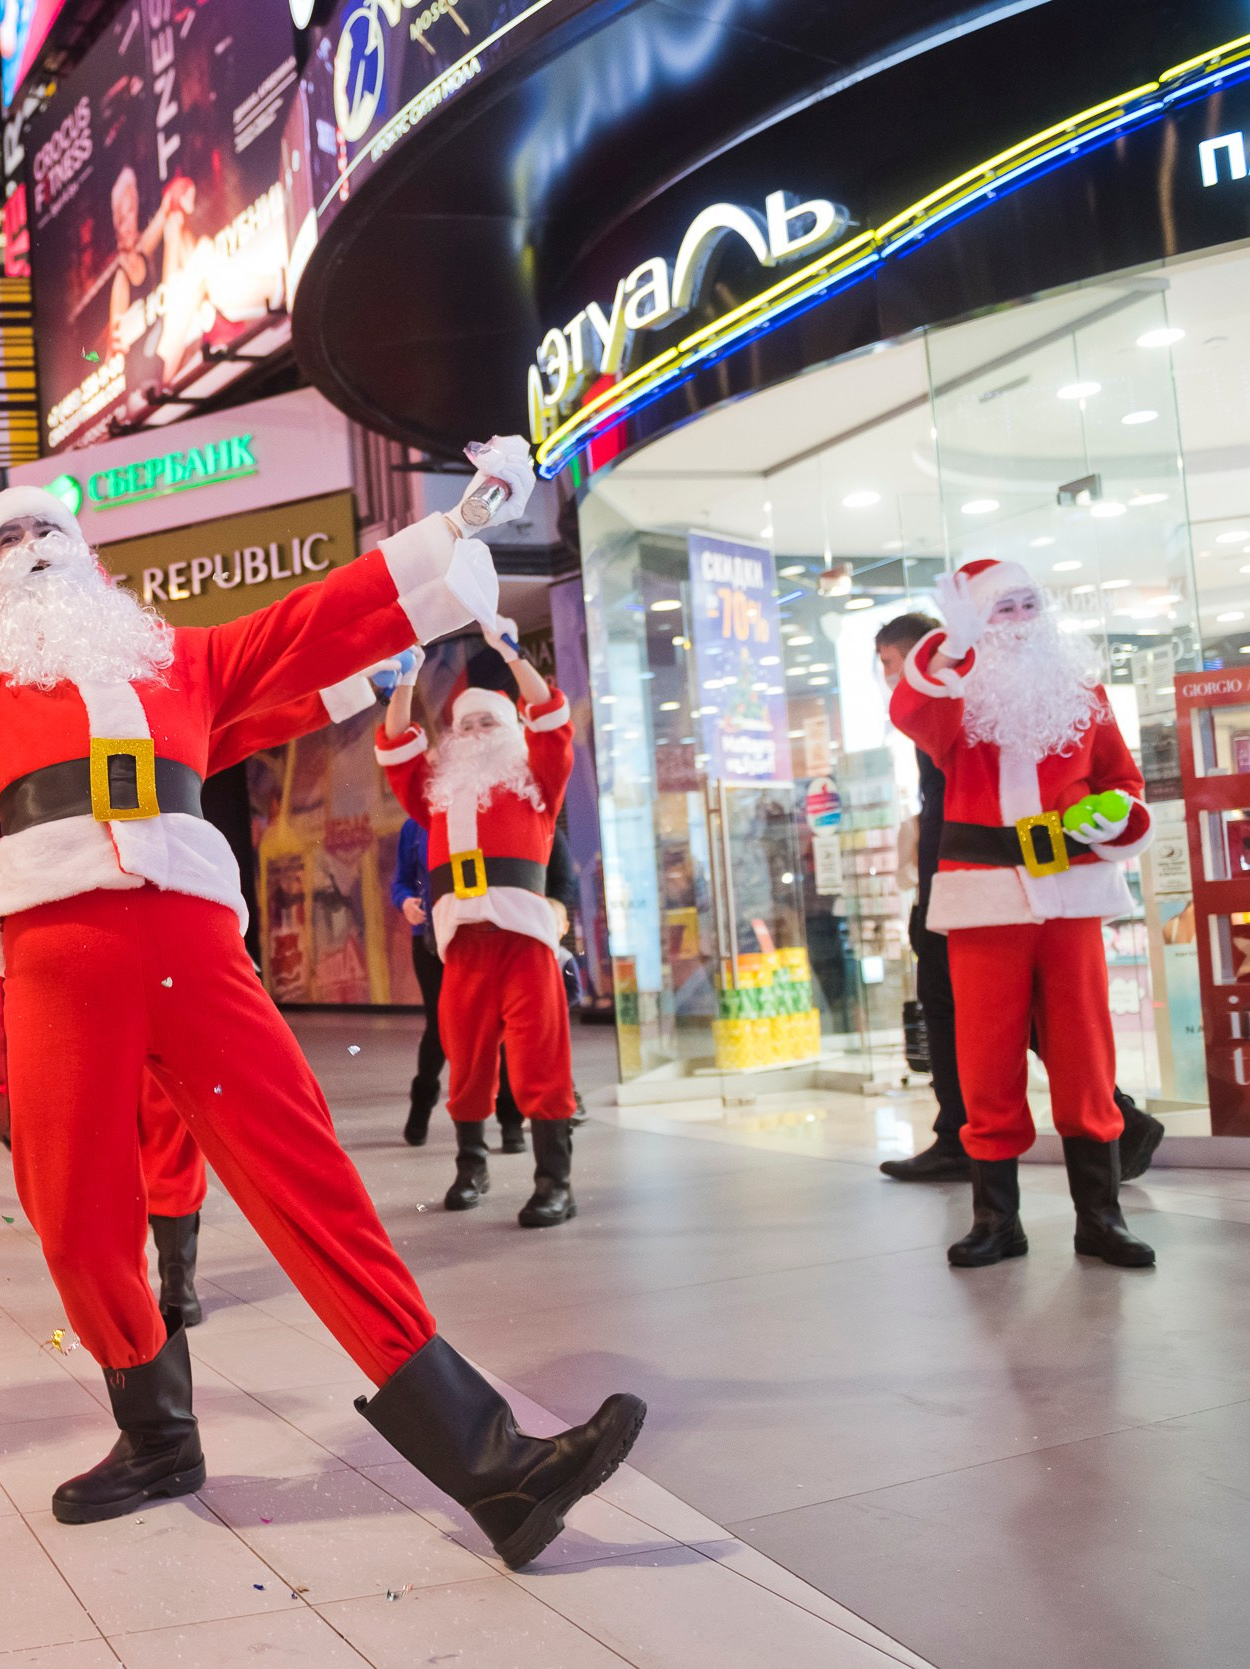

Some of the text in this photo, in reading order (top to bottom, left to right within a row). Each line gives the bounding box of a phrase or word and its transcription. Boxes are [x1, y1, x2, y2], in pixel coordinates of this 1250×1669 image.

[1198, 131, 1250, 188] П
[87, 433, 256, 503] СБЕРБАНК
[142, 532, 331, 605] REPUBLIC
[701, 551, 765, 591] СКИДКИ
[1182, 678, 1243, 699] GIORGIO
